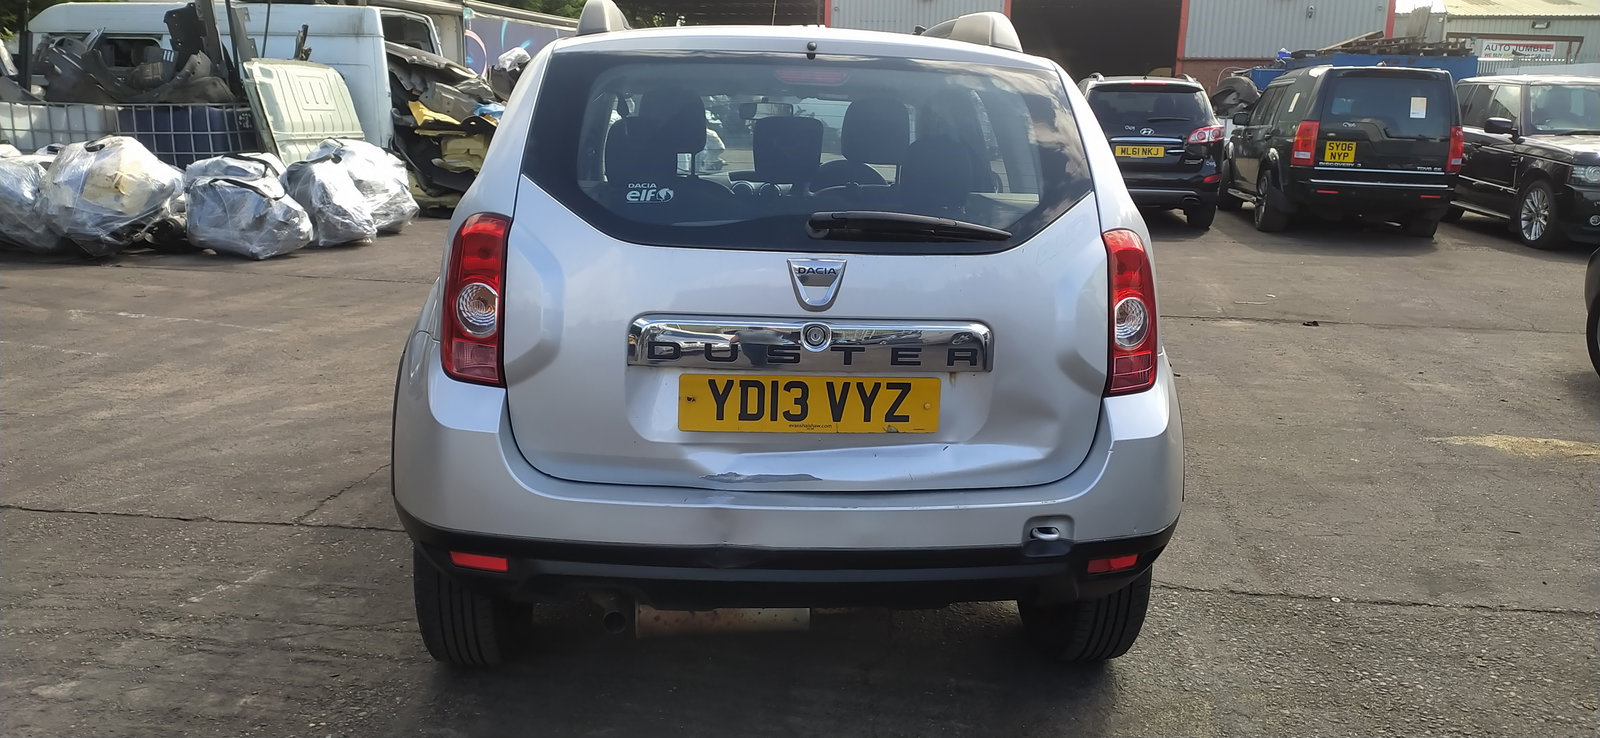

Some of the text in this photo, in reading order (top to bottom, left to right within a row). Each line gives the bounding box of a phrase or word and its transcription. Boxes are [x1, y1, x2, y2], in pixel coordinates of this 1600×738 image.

[1484, 44, 1551, 52] AUTO JUMBLE
[1328, 142, 1354, 151] SY06
[1120, 148, 1159, 156] ML61 NKJ
[1330, 152, 1349, 160] NYP
[626, 189, 657, 201] elf
[797, 267, 837, 275] DACIA
[647, 341, 979, 366] DUSTER
[708, 378, 912, 423] YD13 VYZ
